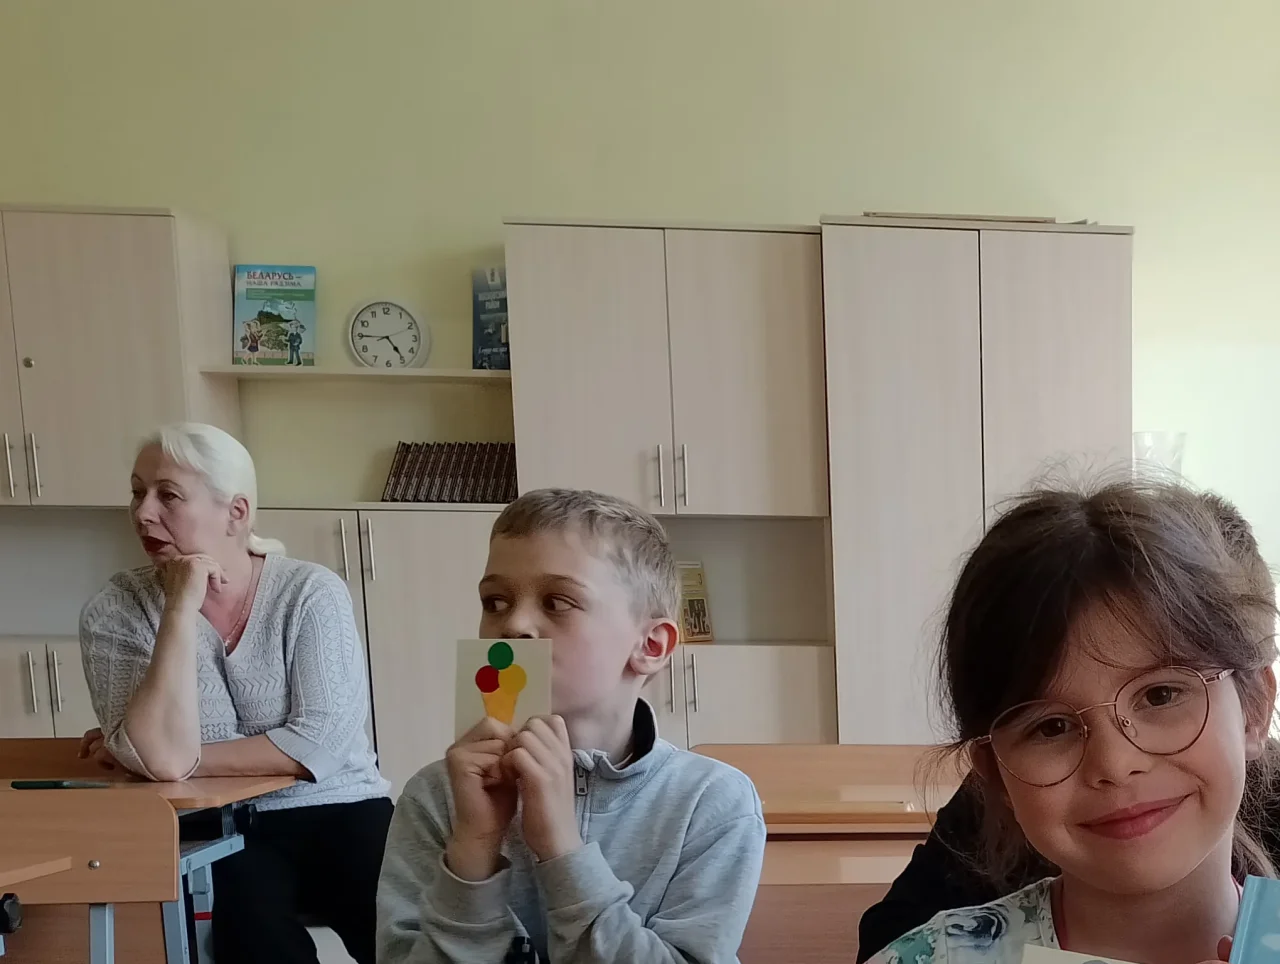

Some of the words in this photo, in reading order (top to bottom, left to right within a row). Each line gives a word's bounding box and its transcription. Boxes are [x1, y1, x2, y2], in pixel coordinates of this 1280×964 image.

[246, 270, 294, 281] БЕЛАРУСЬ
[382, 307, 391, 315] 12
[360, 320, 369, 328] 10
[407, 322, 414, 330] 2
[357, 332, 364, 340] 9
[412, 334, 418, 342] 3
[362, 345, 368, 353] 8
[372, 355, 378, 363] 7
[399, 356, 405, 364] 5
[385, 360, 392, 368] 6
